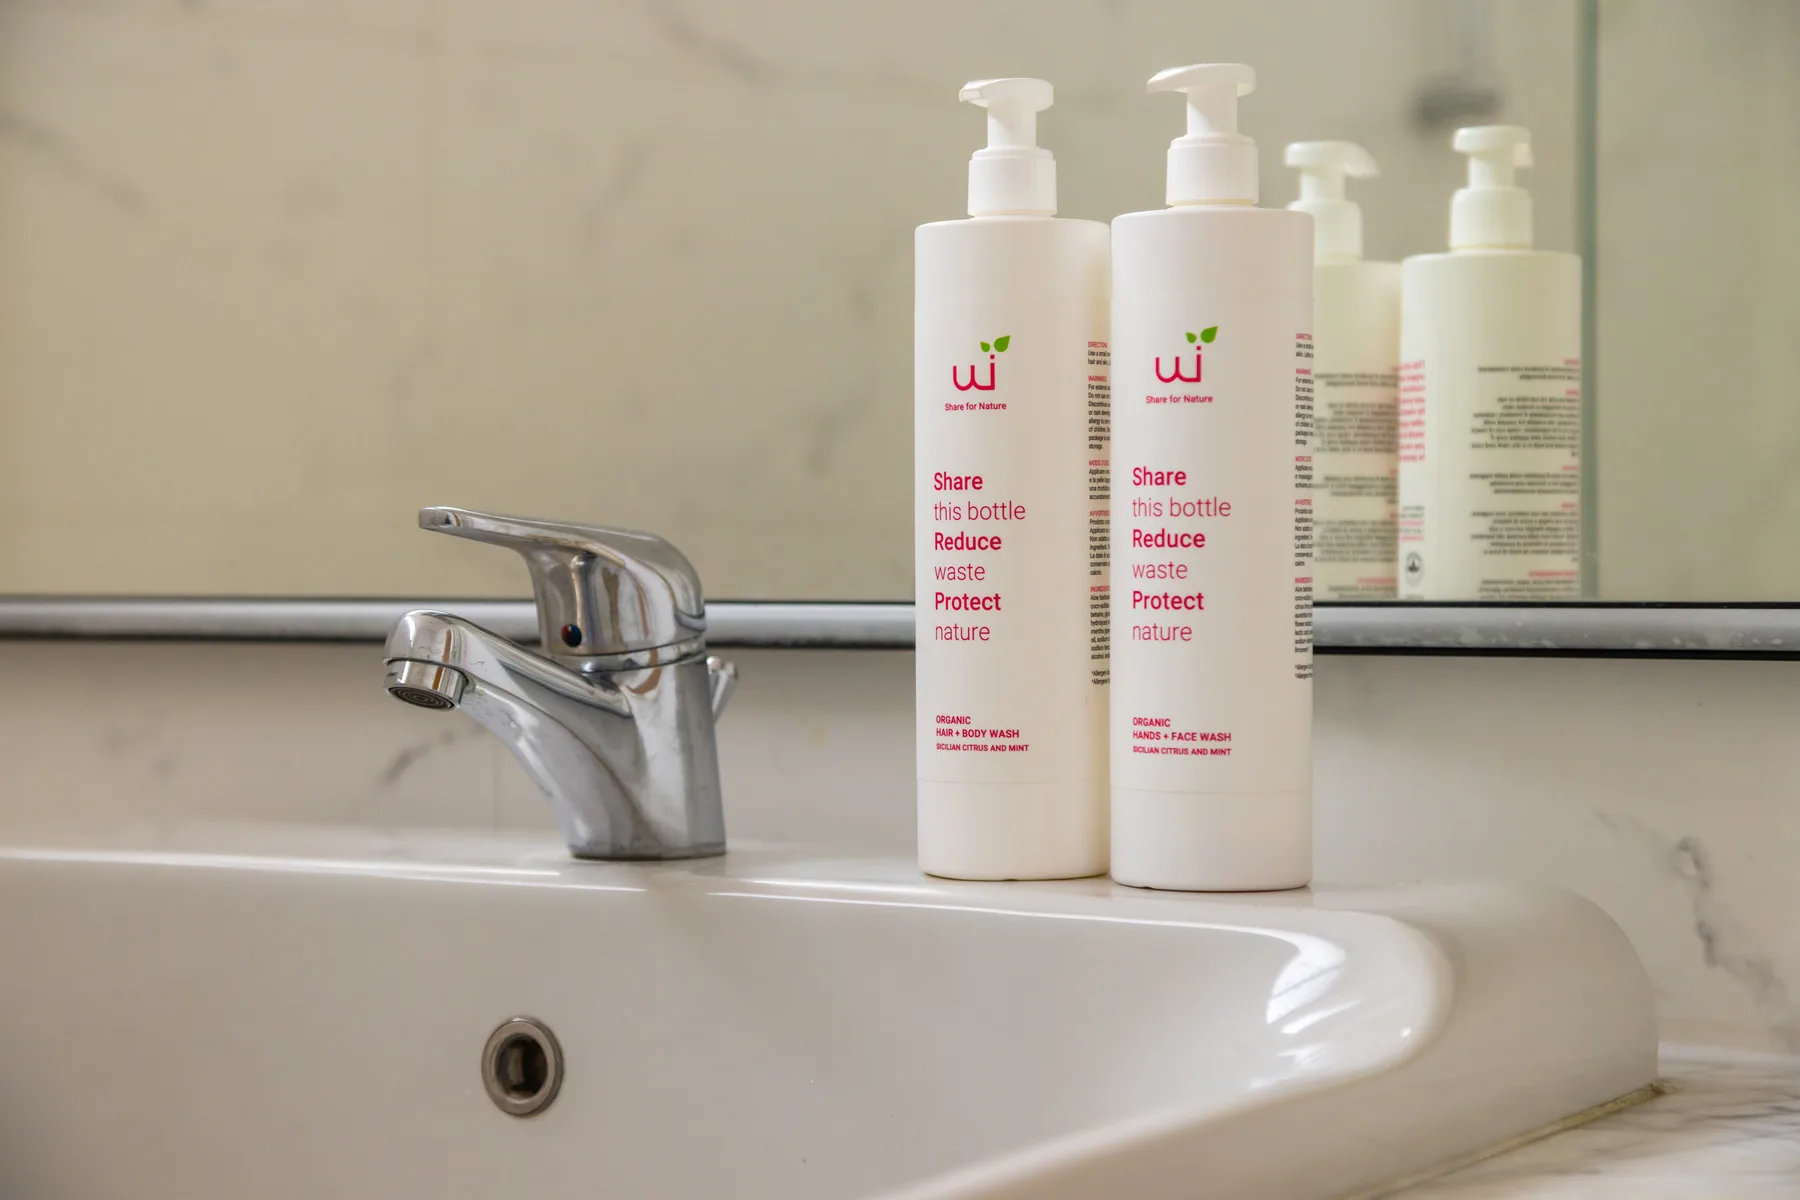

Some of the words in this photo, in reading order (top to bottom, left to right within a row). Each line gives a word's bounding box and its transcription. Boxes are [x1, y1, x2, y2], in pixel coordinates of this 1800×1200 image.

[944, 403, 965, 412] Share
[966, 402, 977, 411] for
[979, 402, 1007, 410] Nature
[1146, 395, 1167, 404] Share
[1169, 394, 1181, 403] for
[1183, 394, 1214, 403] Nature
[933, 471, 984, 491] Share
[1132, 465, 1187, 487] Share
[933, 501, 962, 521] this
[967, 500, 1026, 521] bottle
[1132, 498, 1164, 518] this
[1168, 496, 1232, 518] bottle
[934, 531, 1002, 551] Reduce
[1131, 527, 1206, 549] Reduce
[934, 564, 986, 581] waste
[1132, 561, 1188, 580] waste
[935, 591, 1002, 612] Protect
[1132, 590, 1205, 611] Protect
[936, 624, 991, 642] nature
[1132, 624, 1192, 641] nature
[936, 715, 971, 725] ORGANIC
[1132, 717, 1171, 727] ORGANIC
[936, 728, 954, 737] HAIR
[962, 729, 987, 738] BODY
[989, 730, 1020, 739] WASH
[1132, 730, 1161, 741] HANDS
[1171, 731, 1197, 741] FACE
[1199, 732, 1232, 742] WASH
[936, 743, 961, 751] SICILIAN
[962, 744, 989, 752] CITRUS
[1132, 745, 1159, 754] SICILIAN
[1161, 747, 1189, 755] CITRUS
[1210, 748, 1232, 756] MINT
